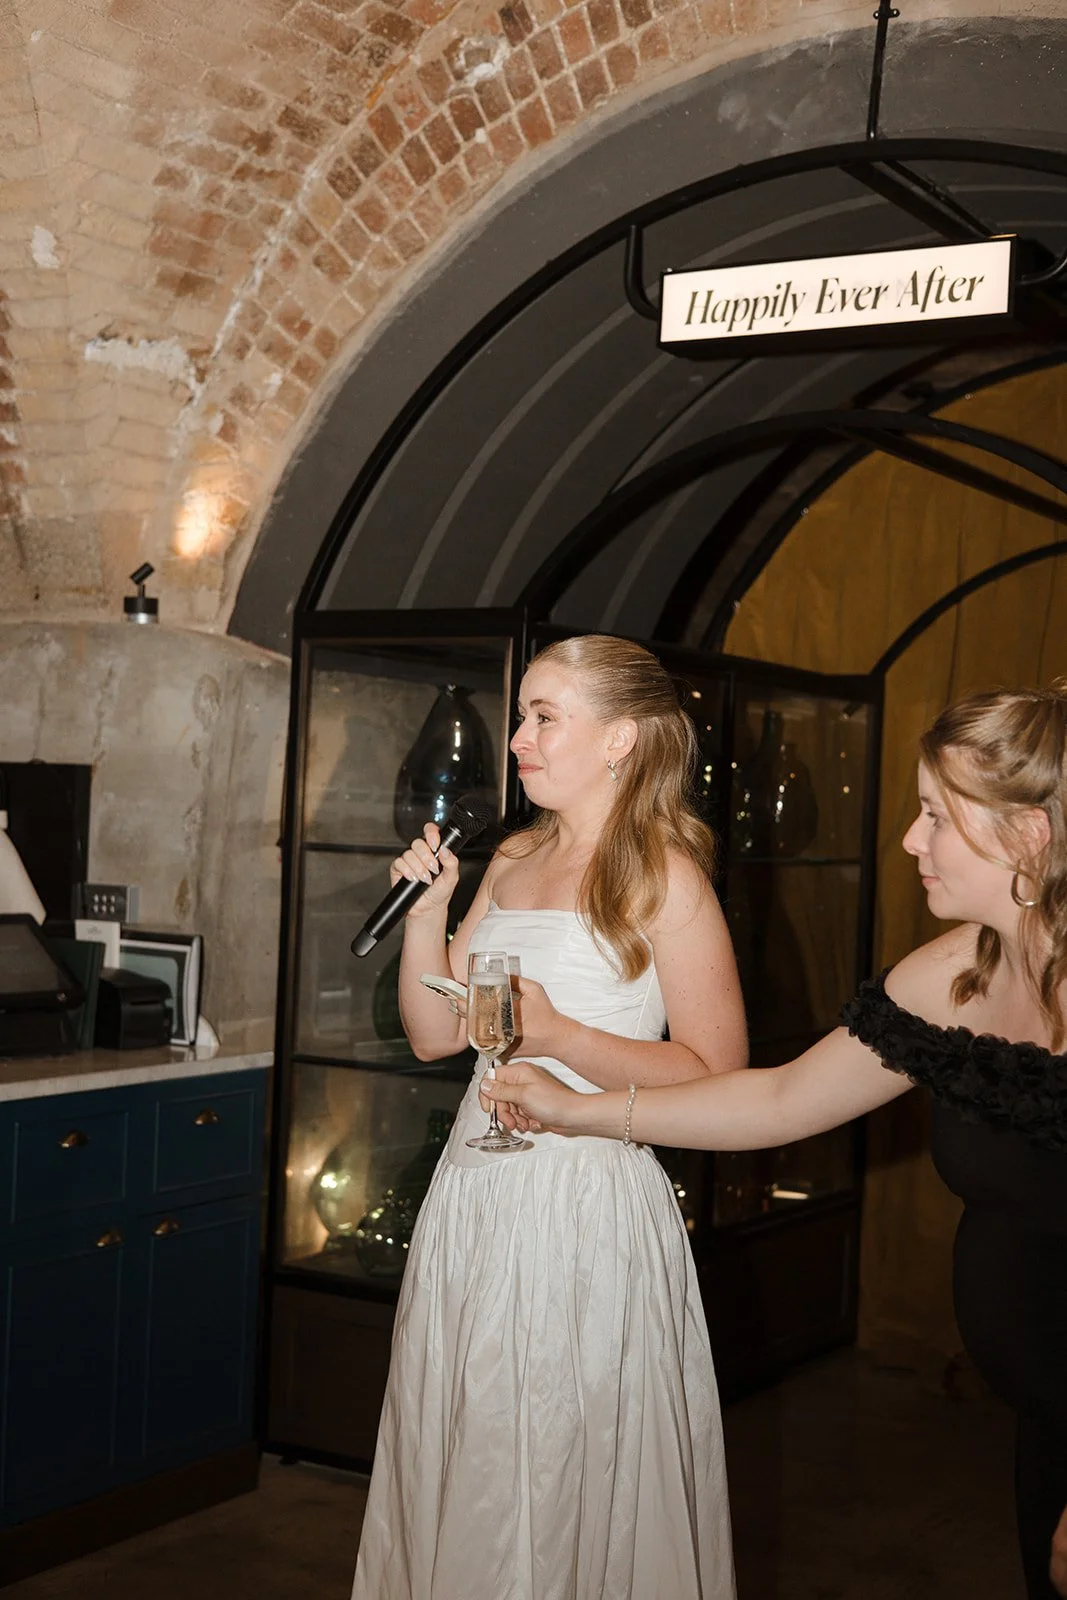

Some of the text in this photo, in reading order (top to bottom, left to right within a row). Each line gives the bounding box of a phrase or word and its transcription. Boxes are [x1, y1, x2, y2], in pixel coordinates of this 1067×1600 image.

[684, 265, 985, 332] Happily Ever After
